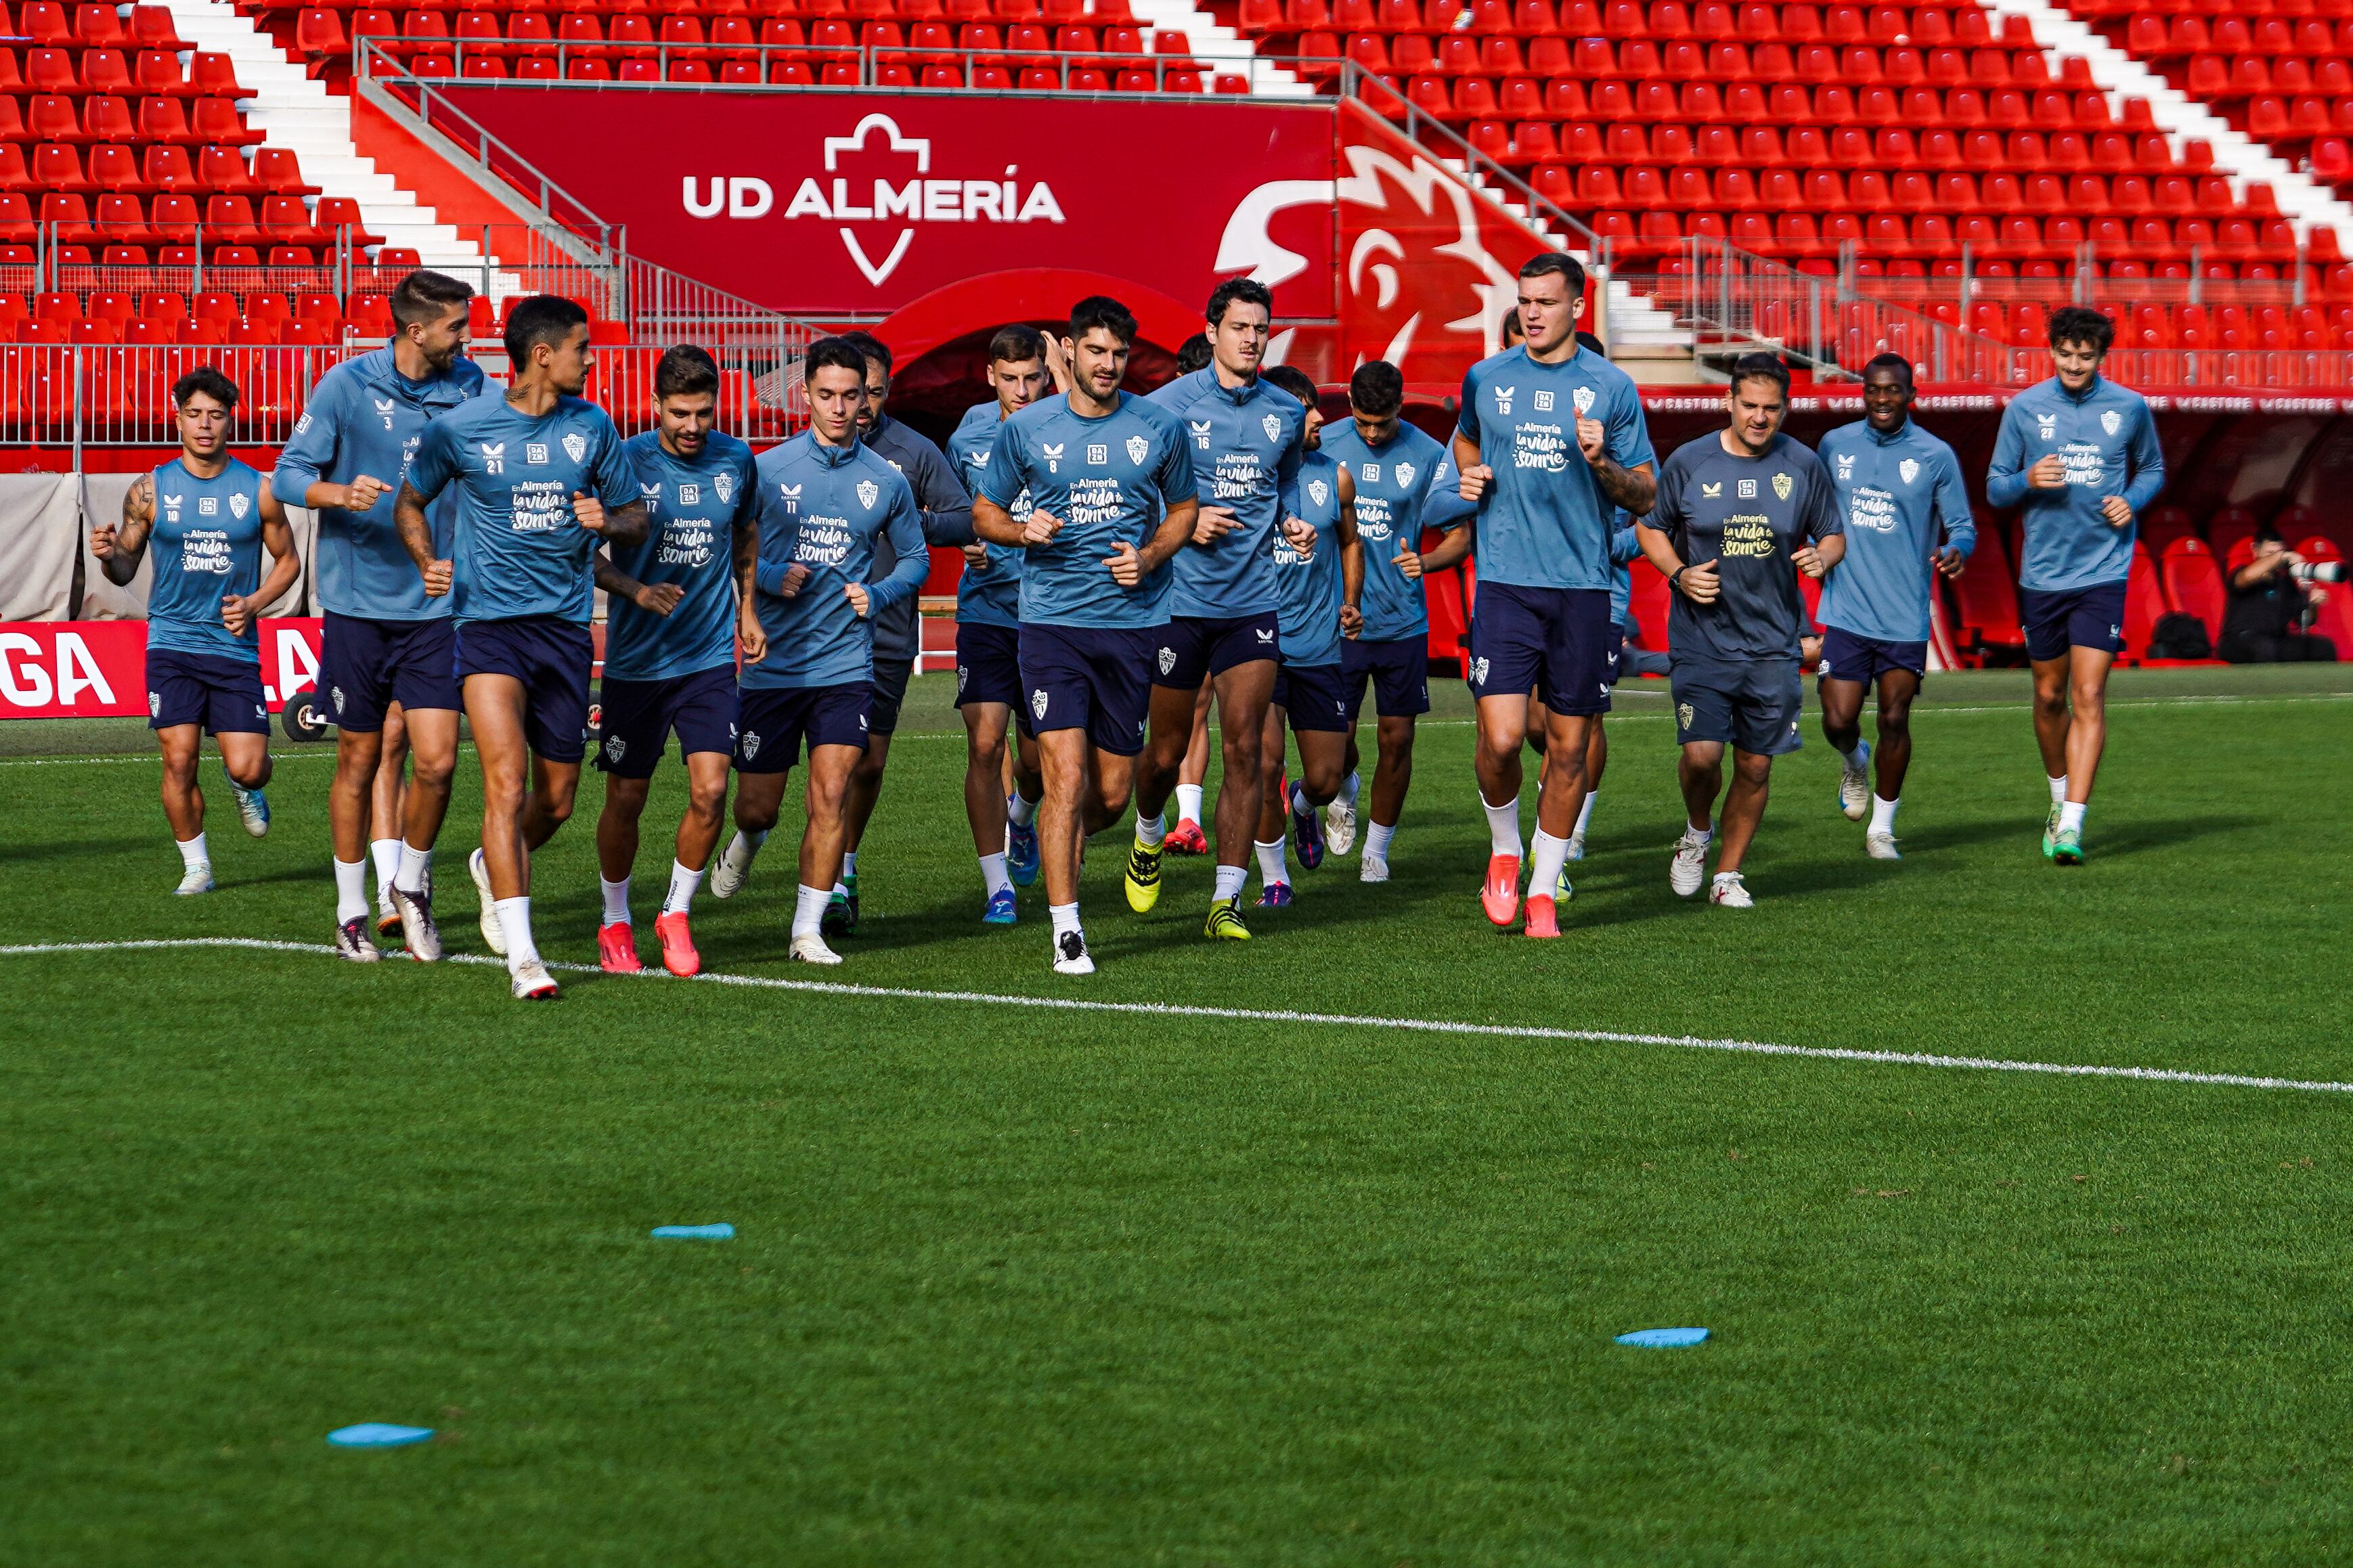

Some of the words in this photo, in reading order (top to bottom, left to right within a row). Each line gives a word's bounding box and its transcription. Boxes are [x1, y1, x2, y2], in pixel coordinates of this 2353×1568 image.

[682, 176, 773, 219] UD
[784, 164, 1066, 224] ALMERÍA
[1498, 401, 1511, 415] 19
[383, 416, 391, 429] 3
[1197, 436, 1210, 450] 16
[1527, 433, 1557, 451] vida
[487, 460, 503, 473] 21
[1049, 460, 1057, 473] 8
[1839, 468, 1851, 479] 24
[525, 491, 558, 509] vida
[1082, 488, 1114, 507] vida
[646, 500, 657, 513] 17
[786, 501, 796, 514] 11
[167, 511, 179, 522] 10
[676, 528, 705, 547] vida
[811, 527, 841, 545] vida
[1734, 523, 1764, 539] vida
[194, 539, 223, 554] vida
